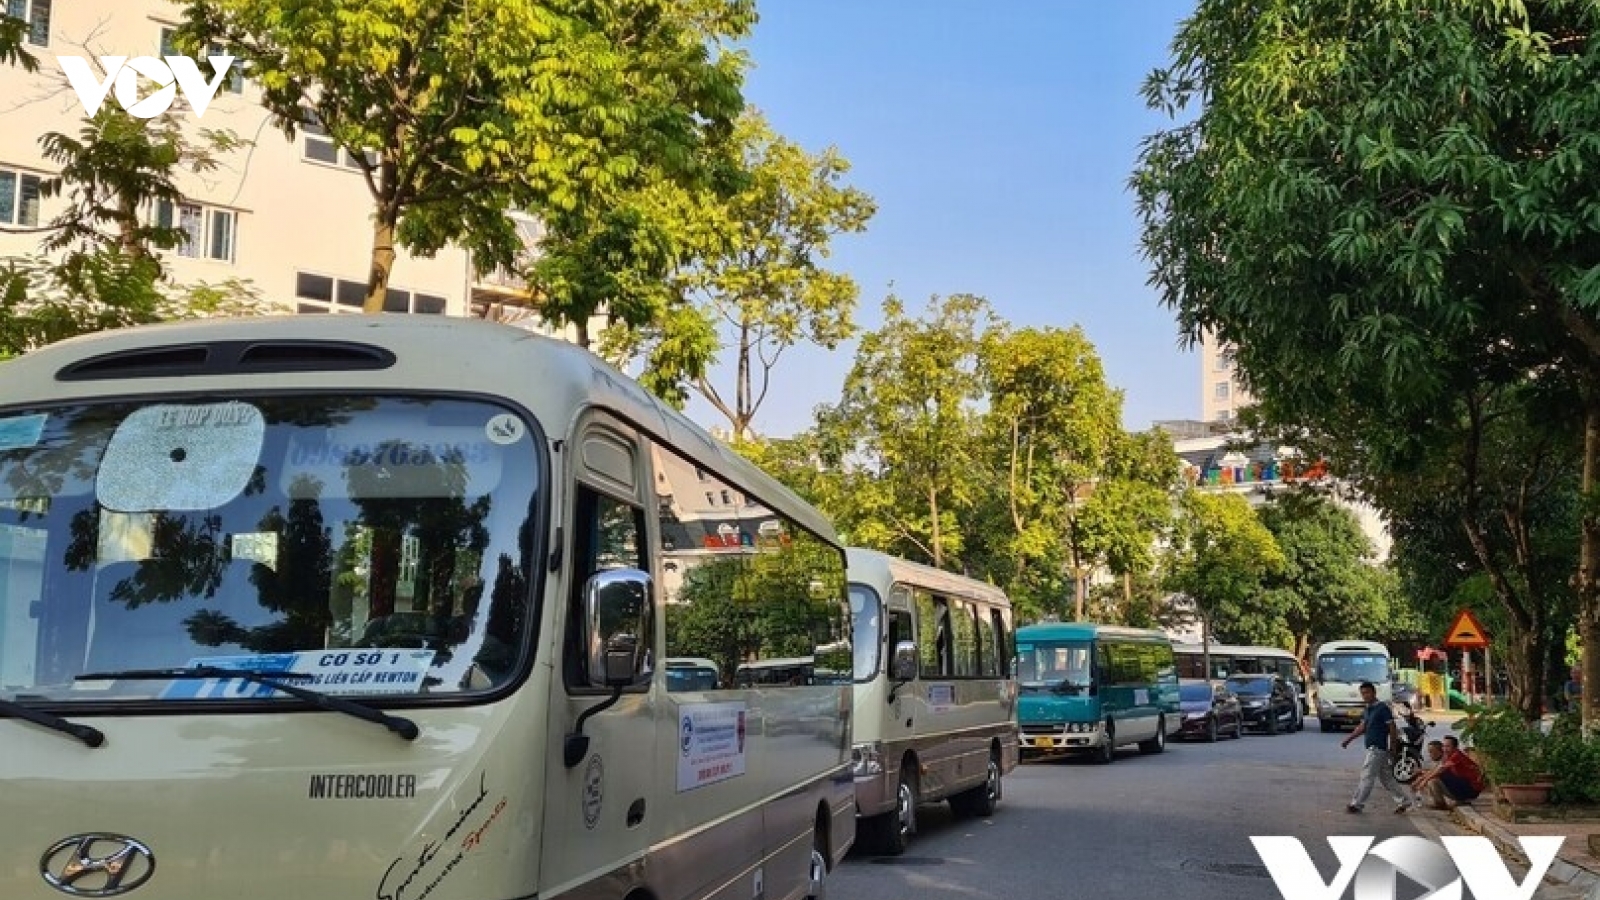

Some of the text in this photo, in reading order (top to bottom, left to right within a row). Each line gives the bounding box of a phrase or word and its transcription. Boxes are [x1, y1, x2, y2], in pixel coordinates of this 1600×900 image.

[390, 653, 401, 665] 1
[373, 671, 419, 684] NEWTON
[308, 774, 417, 799] INTERCOOLER
